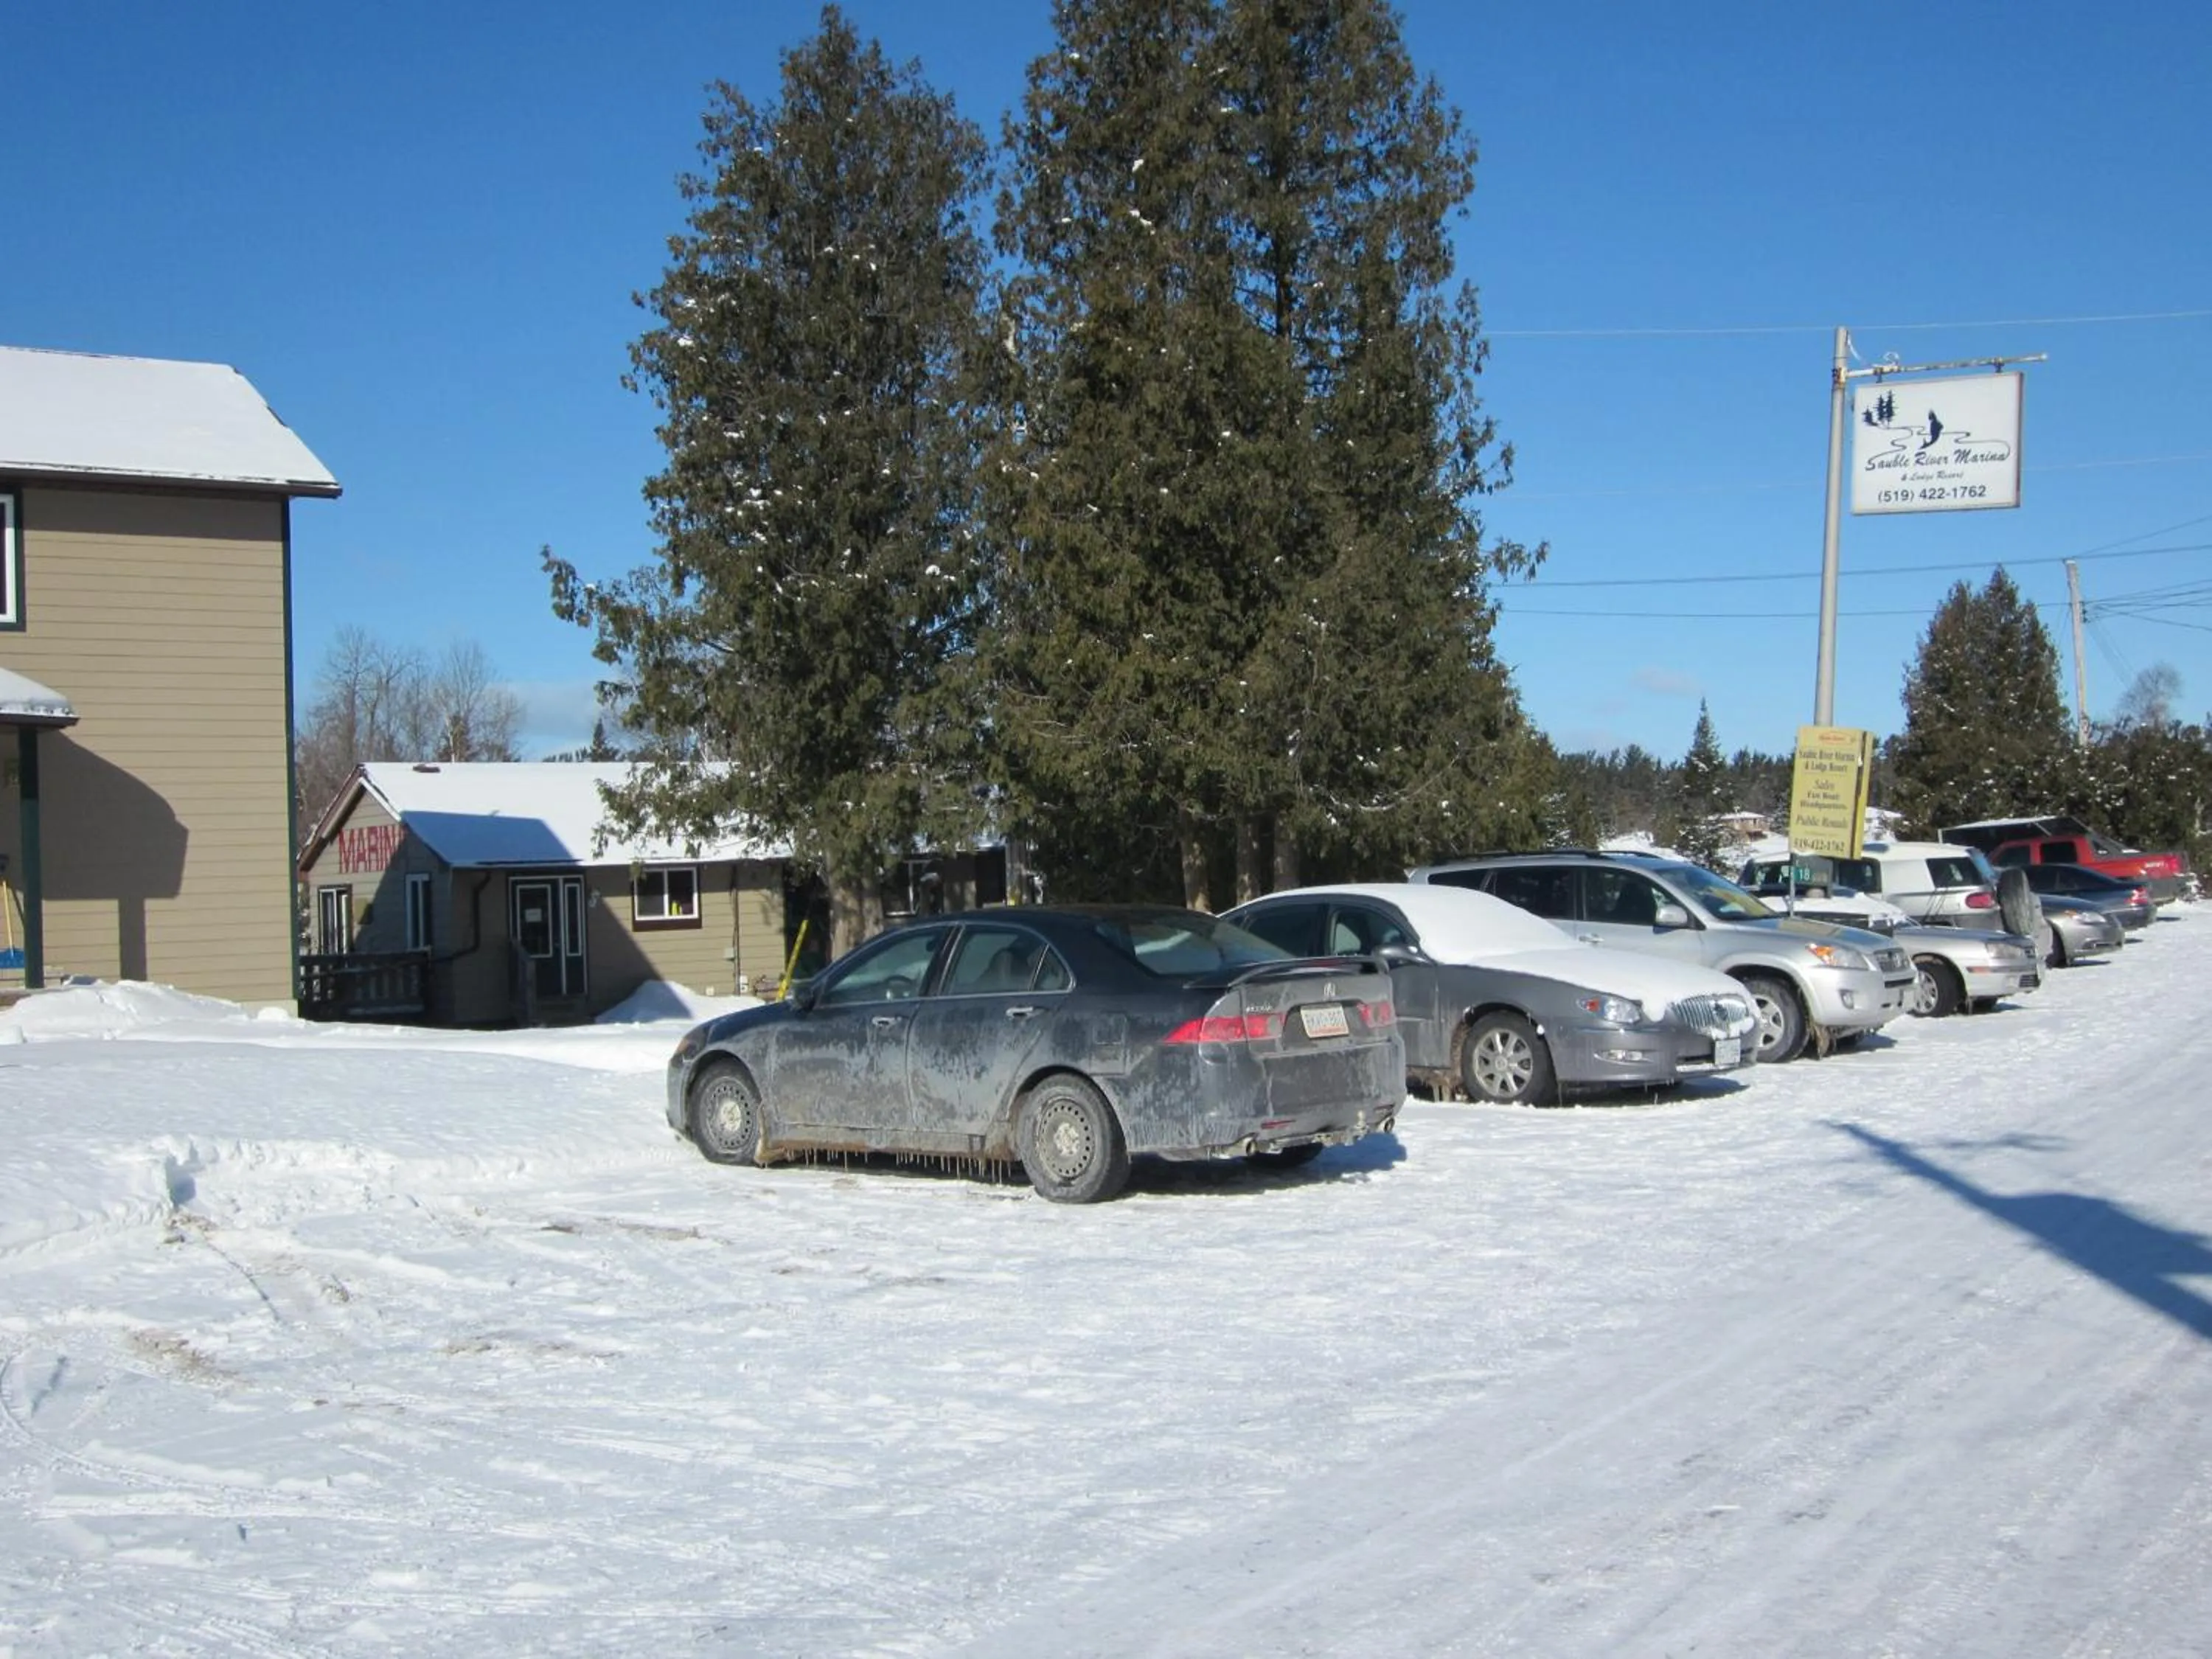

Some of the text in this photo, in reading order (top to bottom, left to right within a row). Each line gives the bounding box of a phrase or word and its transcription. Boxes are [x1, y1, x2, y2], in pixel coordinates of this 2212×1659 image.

[1865, 448, 2008, 471] Sauble River Marina
[1878, 485, 1986, 503] (519) 422-1762
